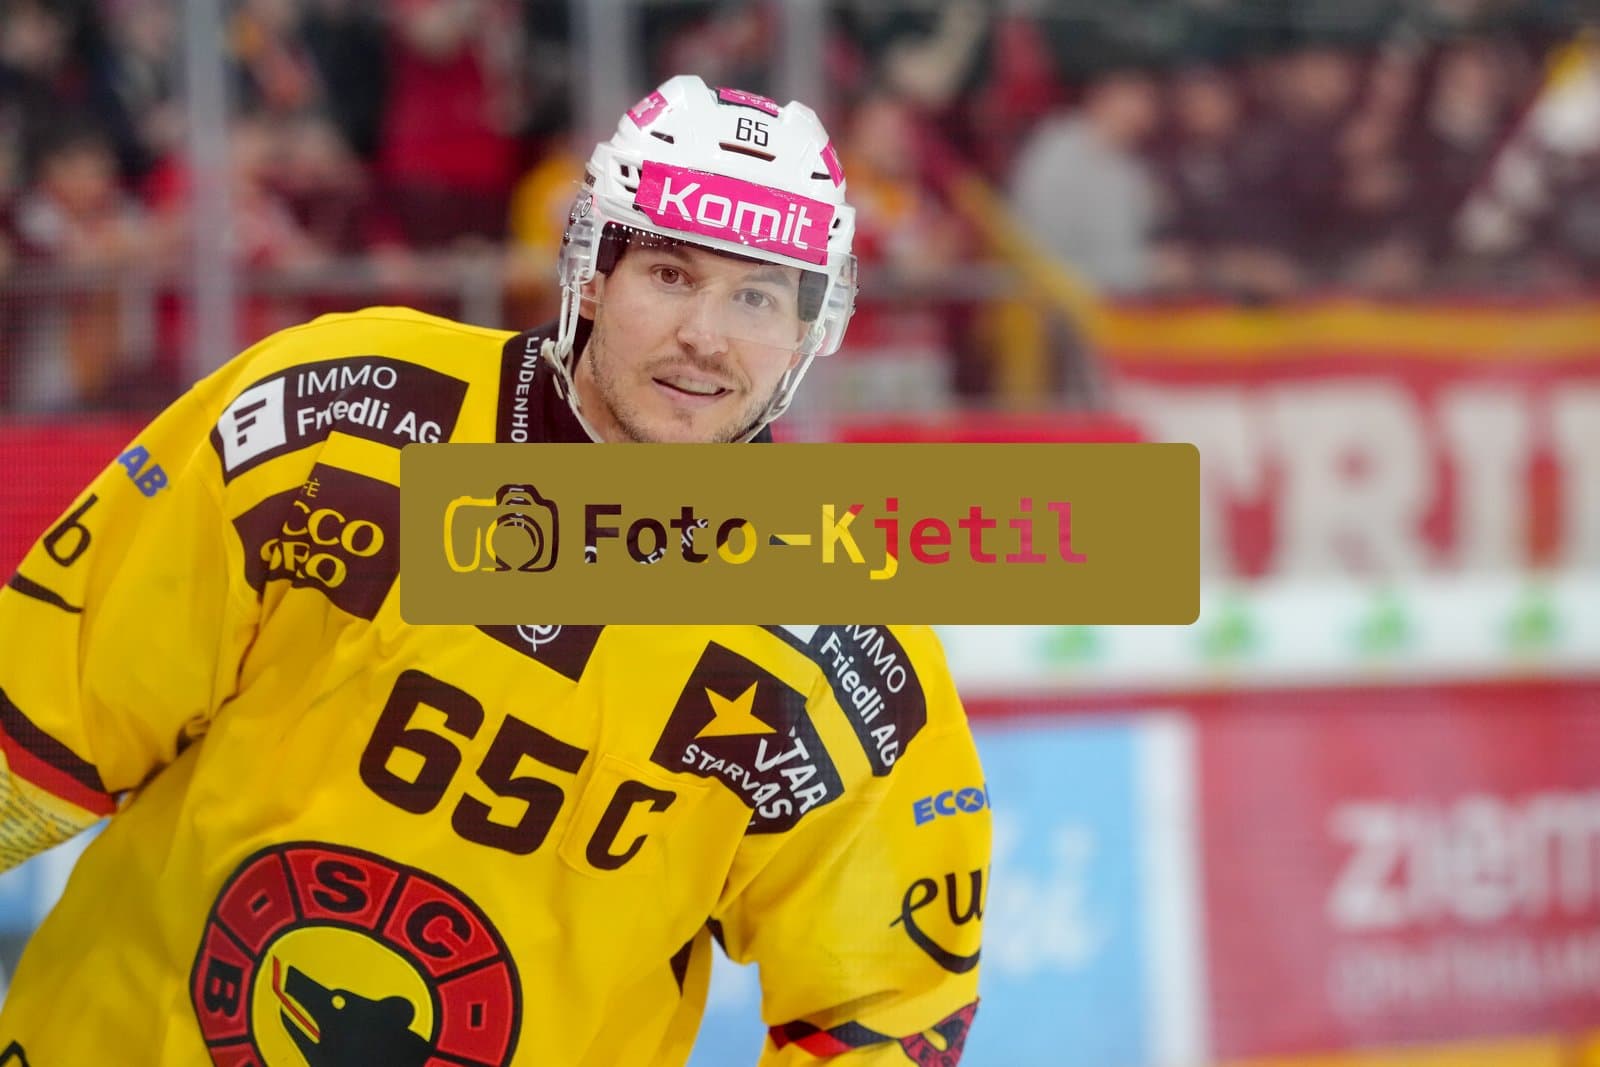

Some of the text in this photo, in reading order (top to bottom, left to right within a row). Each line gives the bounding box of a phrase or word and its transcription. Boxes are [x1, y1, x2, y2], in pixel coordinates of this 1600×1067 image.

[735, 117, 769, 147] 65
[657, 177, 813, 250] Komit
[297, 364, 398, 398] IMMO
[510, 336, 540, 443] LINDENHO
[392, 410, 442, 444] AG
[845, 625, 907, 694] MMO
[820, 631, 899, 767] Friedli AG
[358, 668, 590, 856] 65
[585, 779, 678, 871] C
[913, 783, 991, 827] ECO
